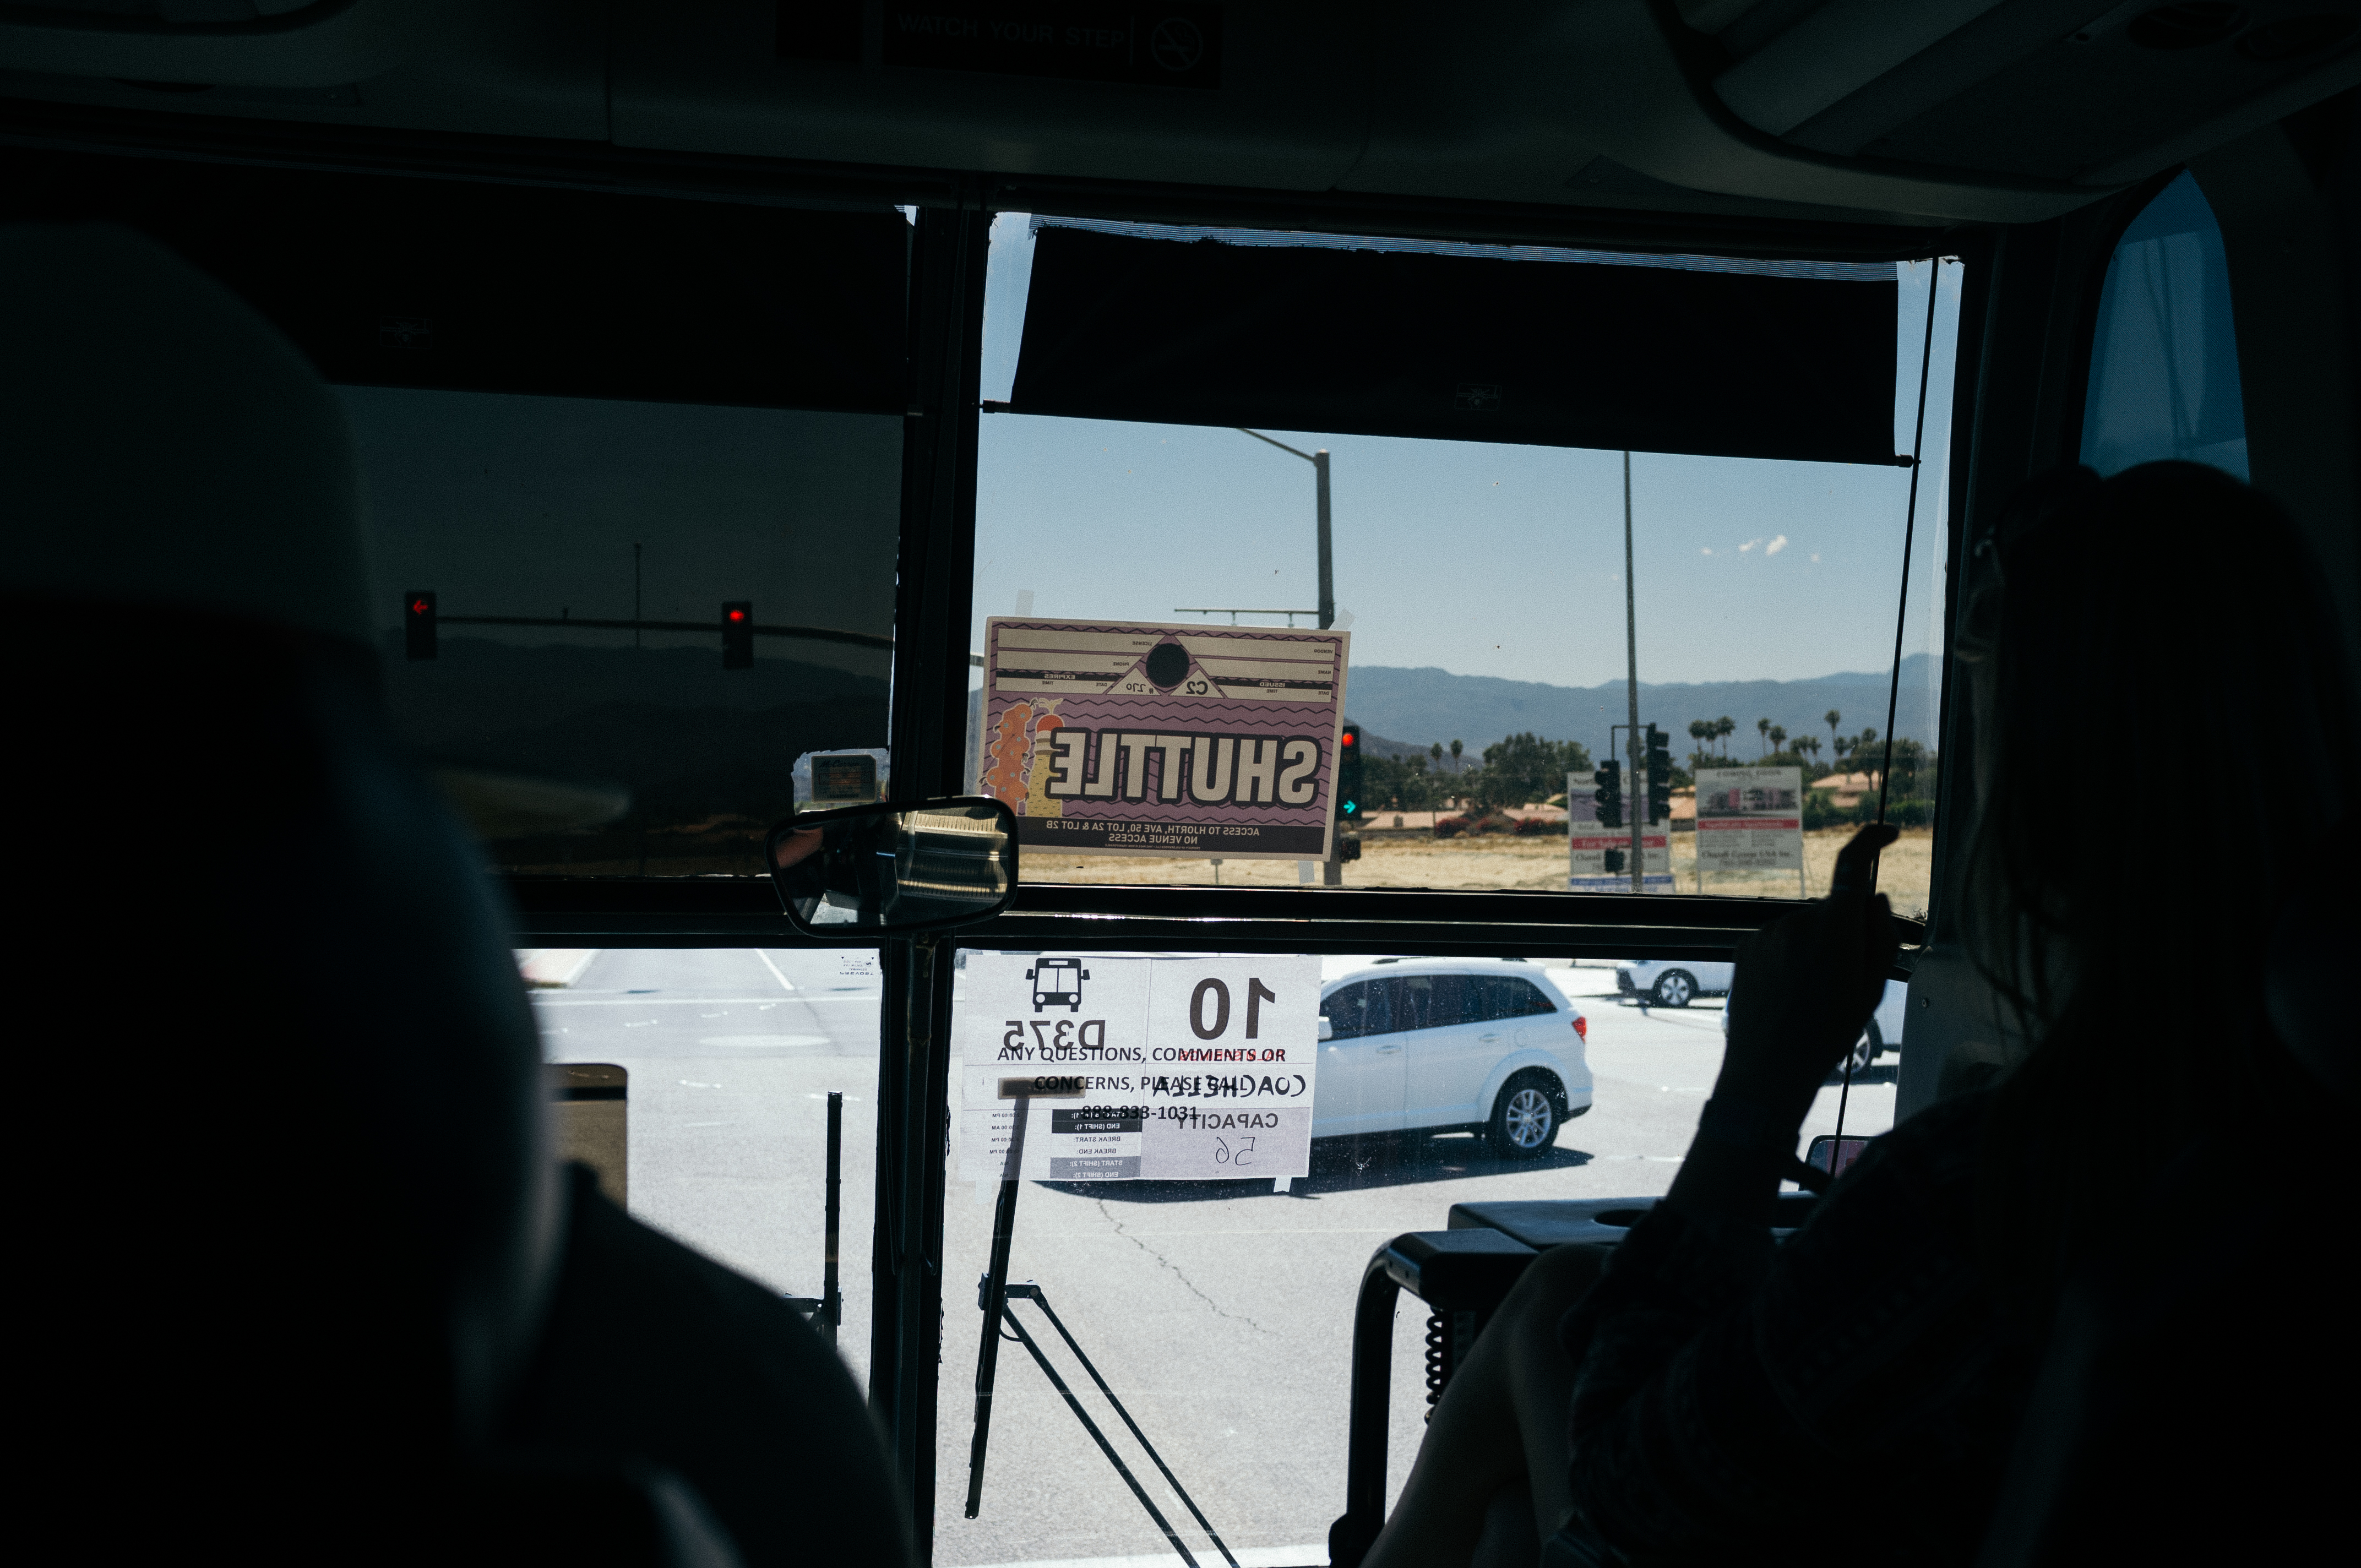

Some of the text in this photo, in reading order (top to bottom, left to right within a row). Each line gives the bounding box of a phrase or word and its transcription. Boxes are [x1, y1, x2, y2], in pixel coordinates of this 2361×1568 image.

[897, 13, 1125, 48] WATCH YOUR STEP
[997, 1047, 1286, 1064] ANY QUESTIONS, COMMENTS OR
[1034, 1076, 1248, 1093] CONCERNS, PLEASE CALL
